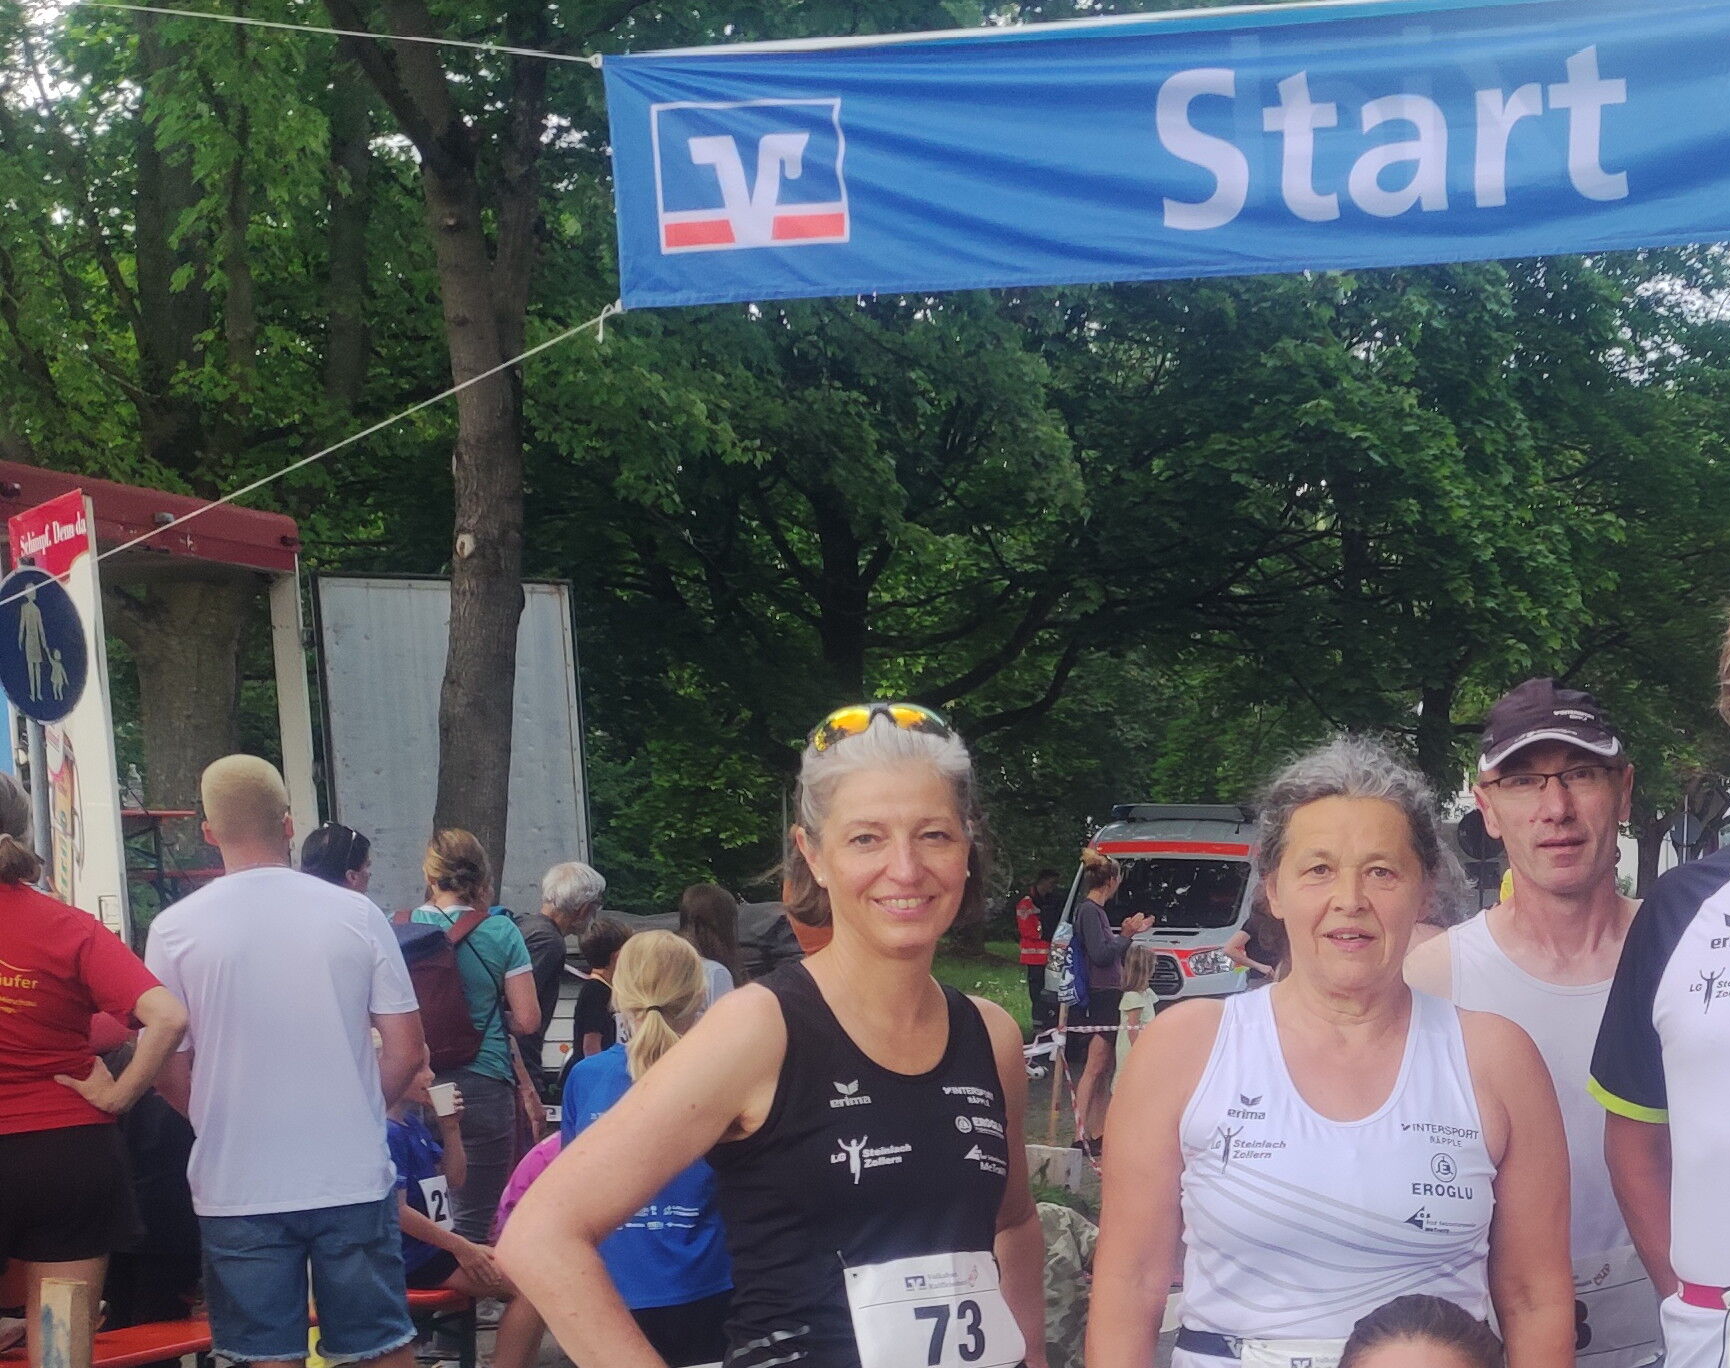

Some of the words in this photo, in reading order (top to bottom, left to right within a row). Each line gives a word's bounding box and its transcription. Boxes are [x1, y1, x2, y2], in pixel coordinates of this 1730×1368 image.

[1155, 44, 1630, 231] Start
[1690, 983, 1702, 993] LG
[830, 1095, 872, 1108] erima
[1227, 1108, 1266, 1120] erima
[1412, 1124, 1479, 1140] INTERSPORT
[1233, 1139, 1287, 1150] Steinlach
[1233, 1150, 1272, 1160] Zollern
[1412, 1183, 1473, 1200] EROGLU
[914, 1300, 985, 1366] 73
